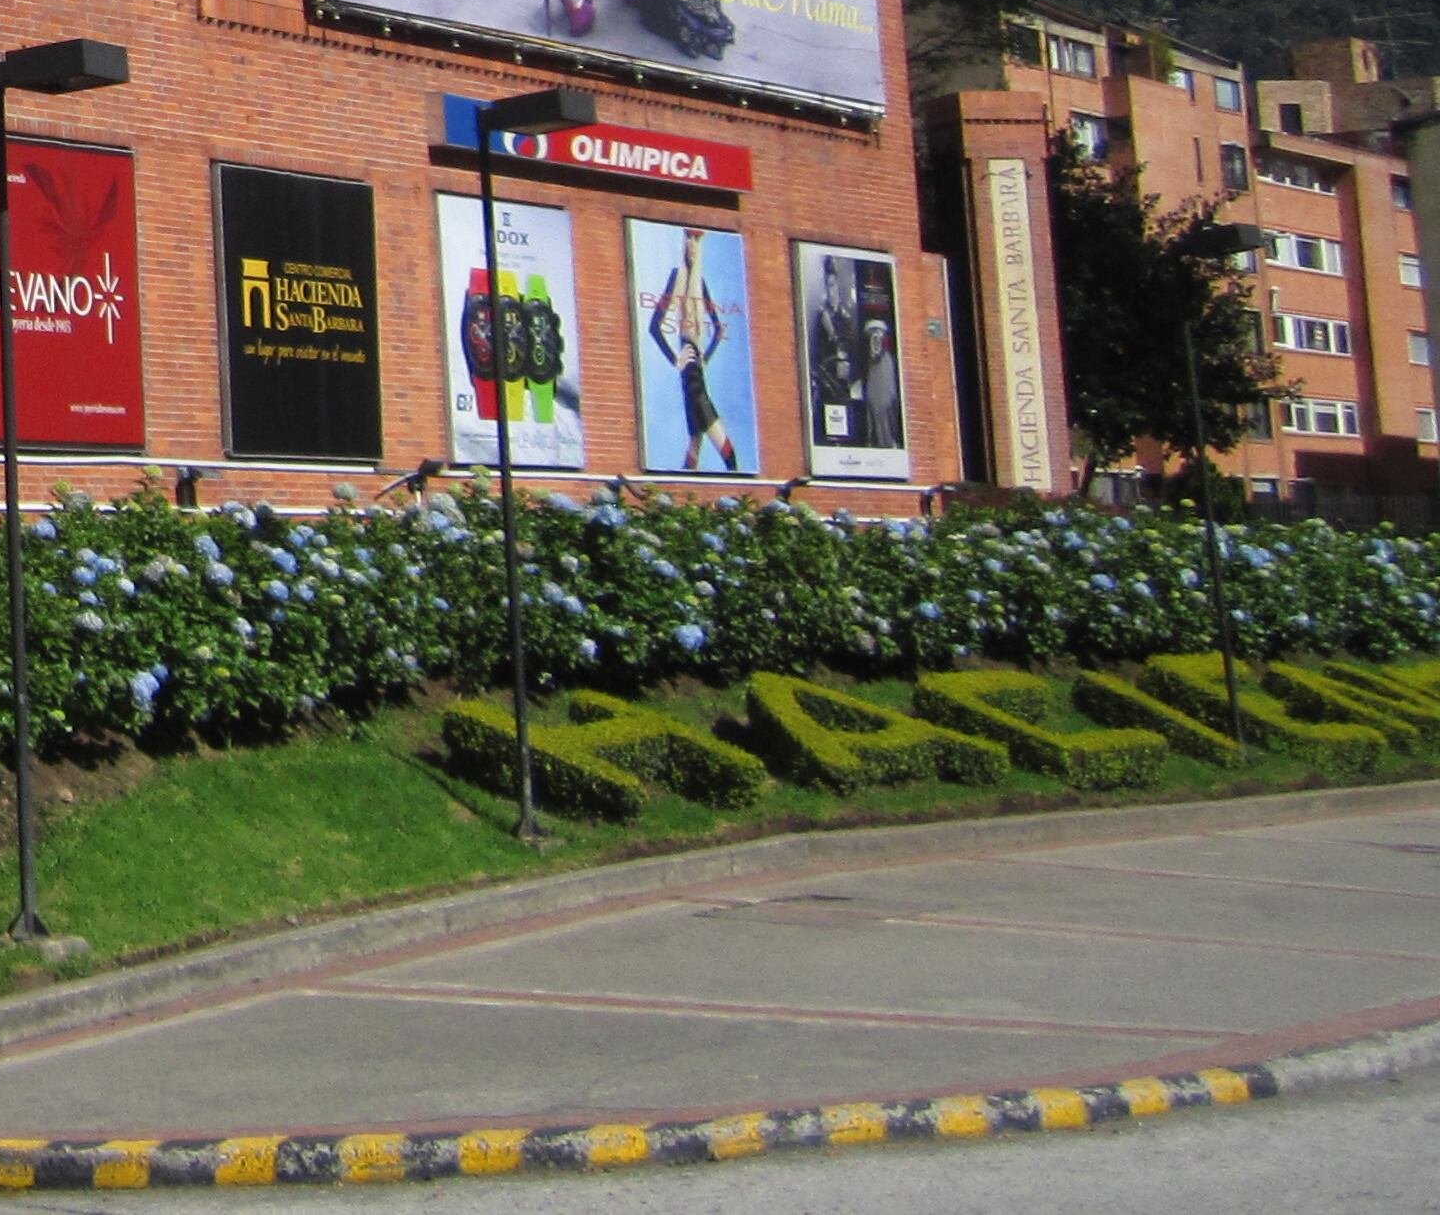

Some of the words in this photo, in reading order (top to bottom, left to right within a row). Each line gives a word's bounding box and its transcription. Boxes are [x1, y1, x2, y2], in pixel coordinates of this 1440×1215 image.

[569, 133, 710, 182] OLIMPICA
[496, 229, 530, 246] DOX
[998, 166, 1025, 266] BARBARA
[274, 276, 364, 309] HACIENDA
[275, 302, 313, 332] SANTA
[1006, 278, 1032, 354] SANTA
[1014, 366, 1042, 483] HACIENDA
